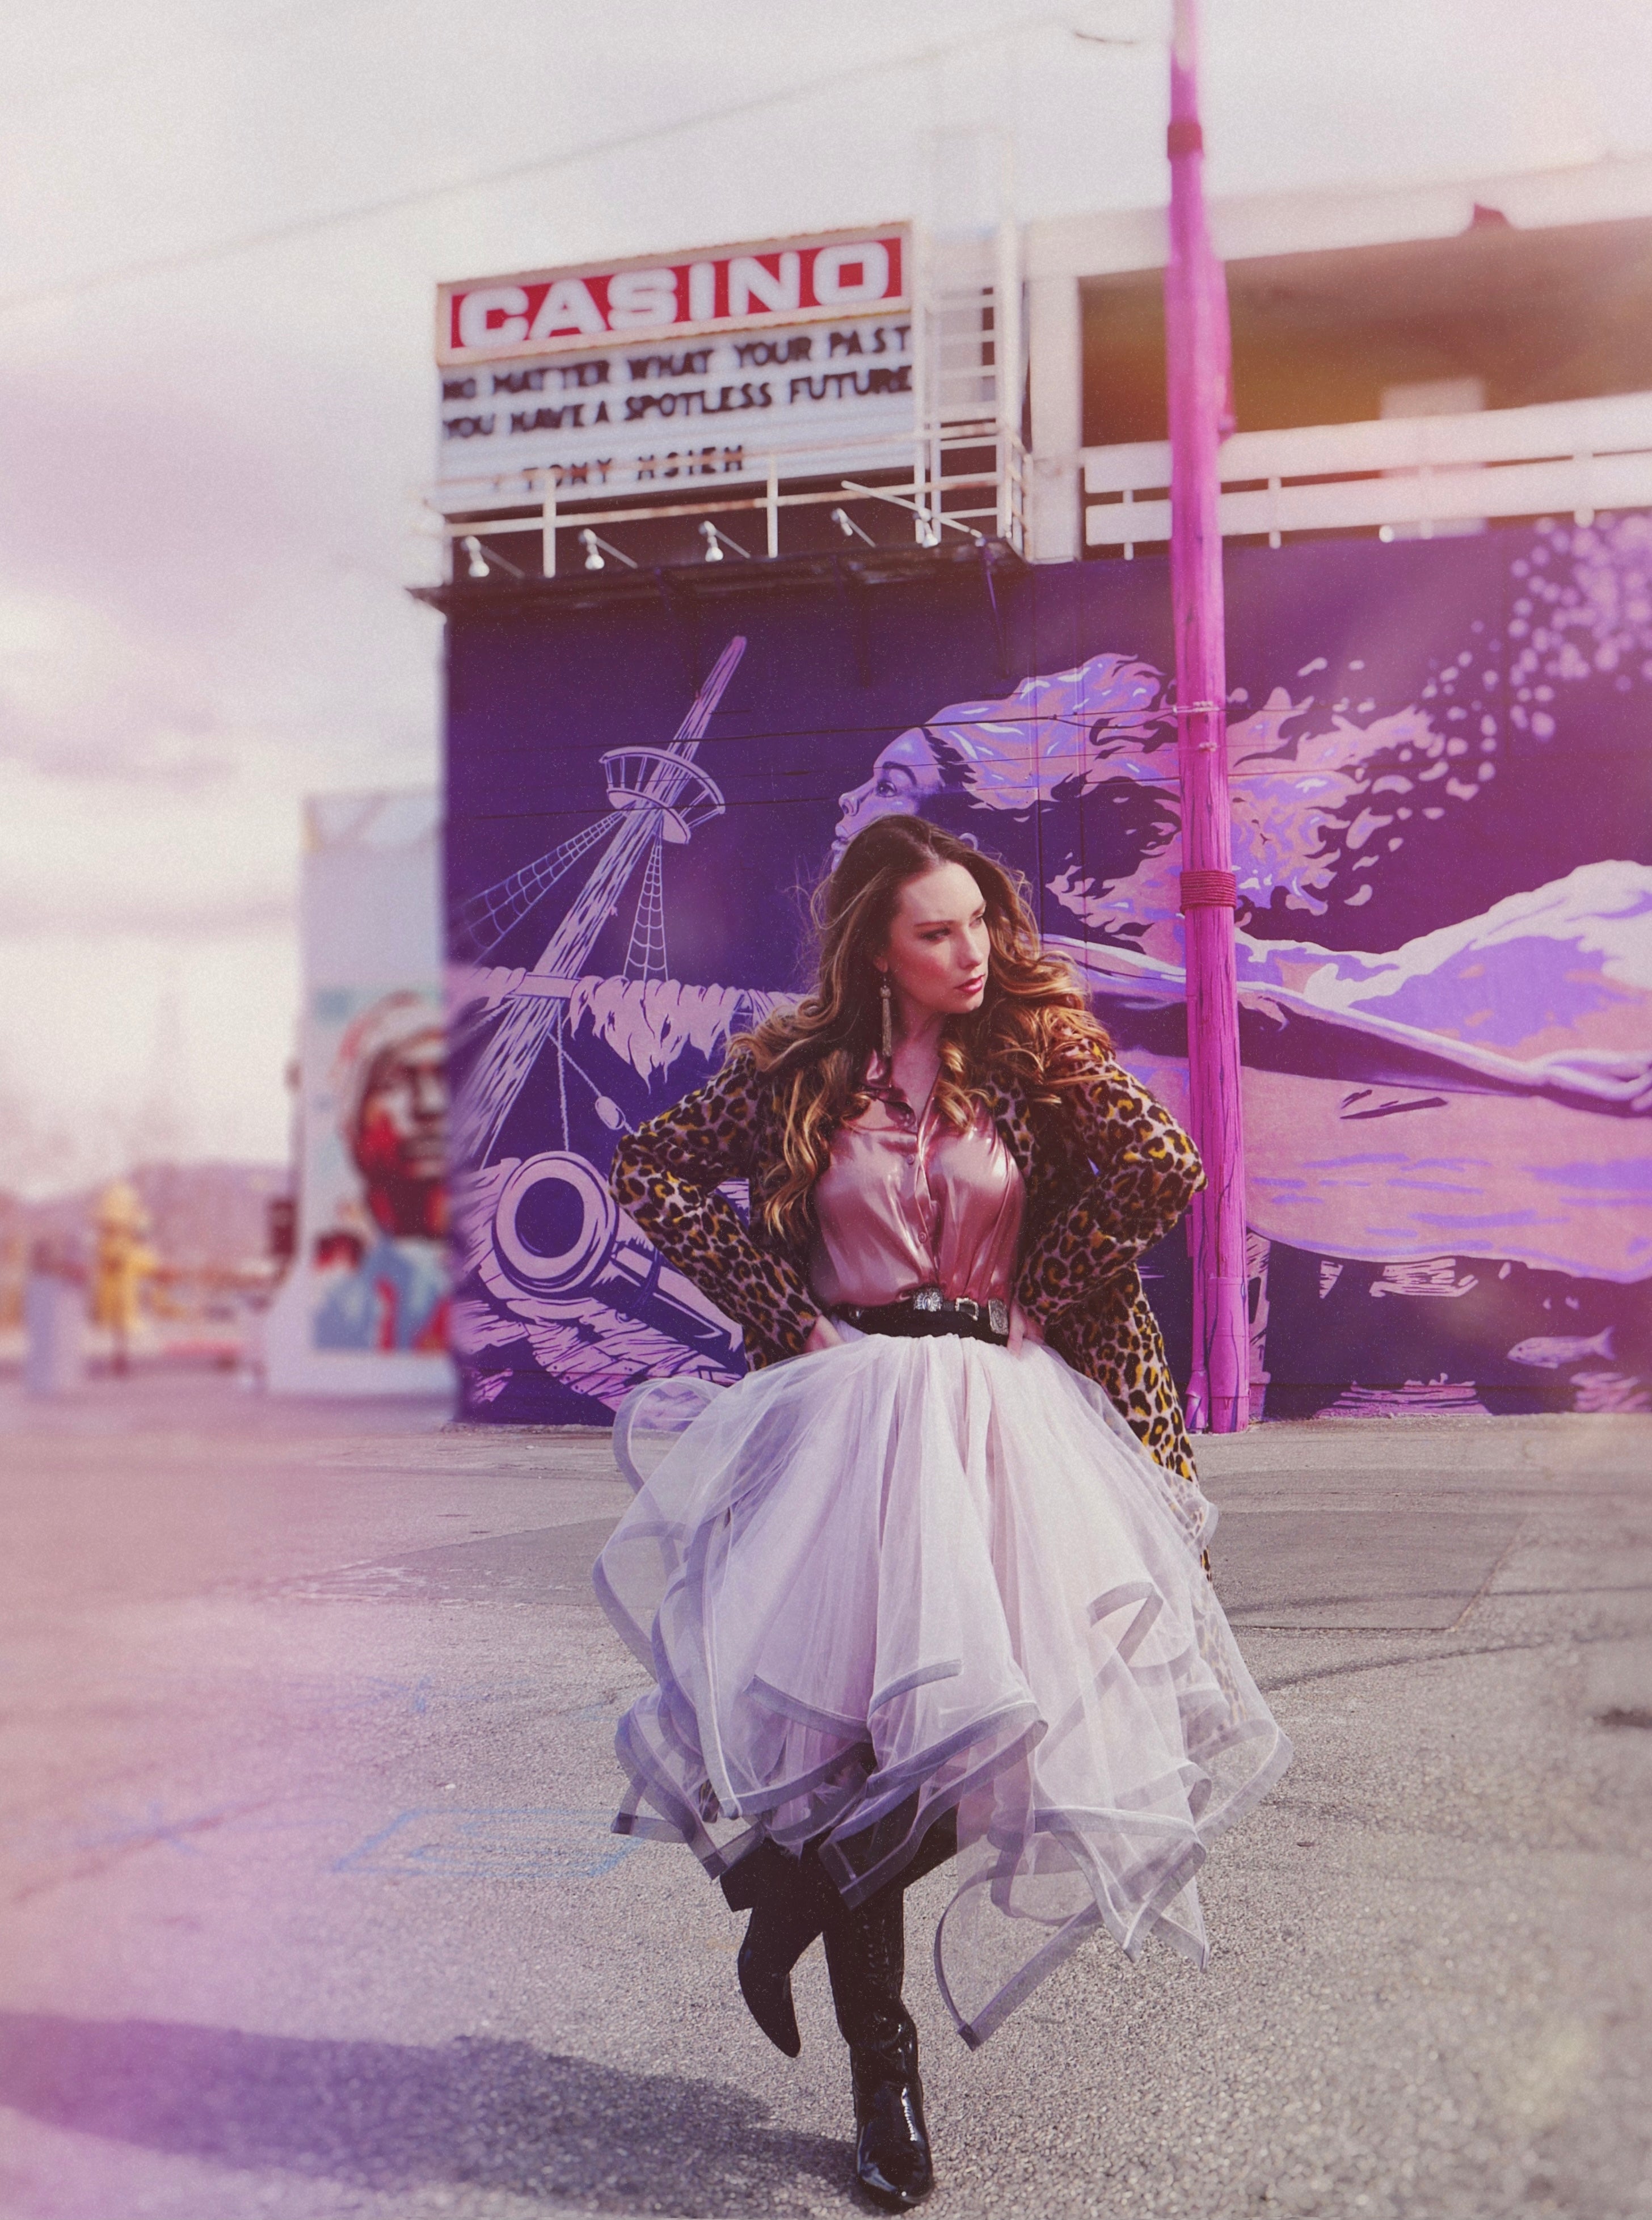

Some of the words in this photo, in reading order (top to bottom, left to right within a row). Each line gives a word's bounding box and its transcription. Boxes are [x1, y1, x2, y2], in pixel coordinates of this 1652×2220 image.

[459, 241, 888, 347] CASINO
[627, 349, 714, 380] WHAT
[735, 337, 812, 368] YOUR
[830, 326, 911, 358] PAST
[442, 415, 495, 439] YOU
[511, 403, 585, 433] HAVE
[595, 400, 609, 423] A
[624, 382, 772, 421] SPOTLESS
[789, 365, 912, 405] FUTURE
[521, 458, 612, 491] TONY
[637, 445, 743, 481] HSIEH
